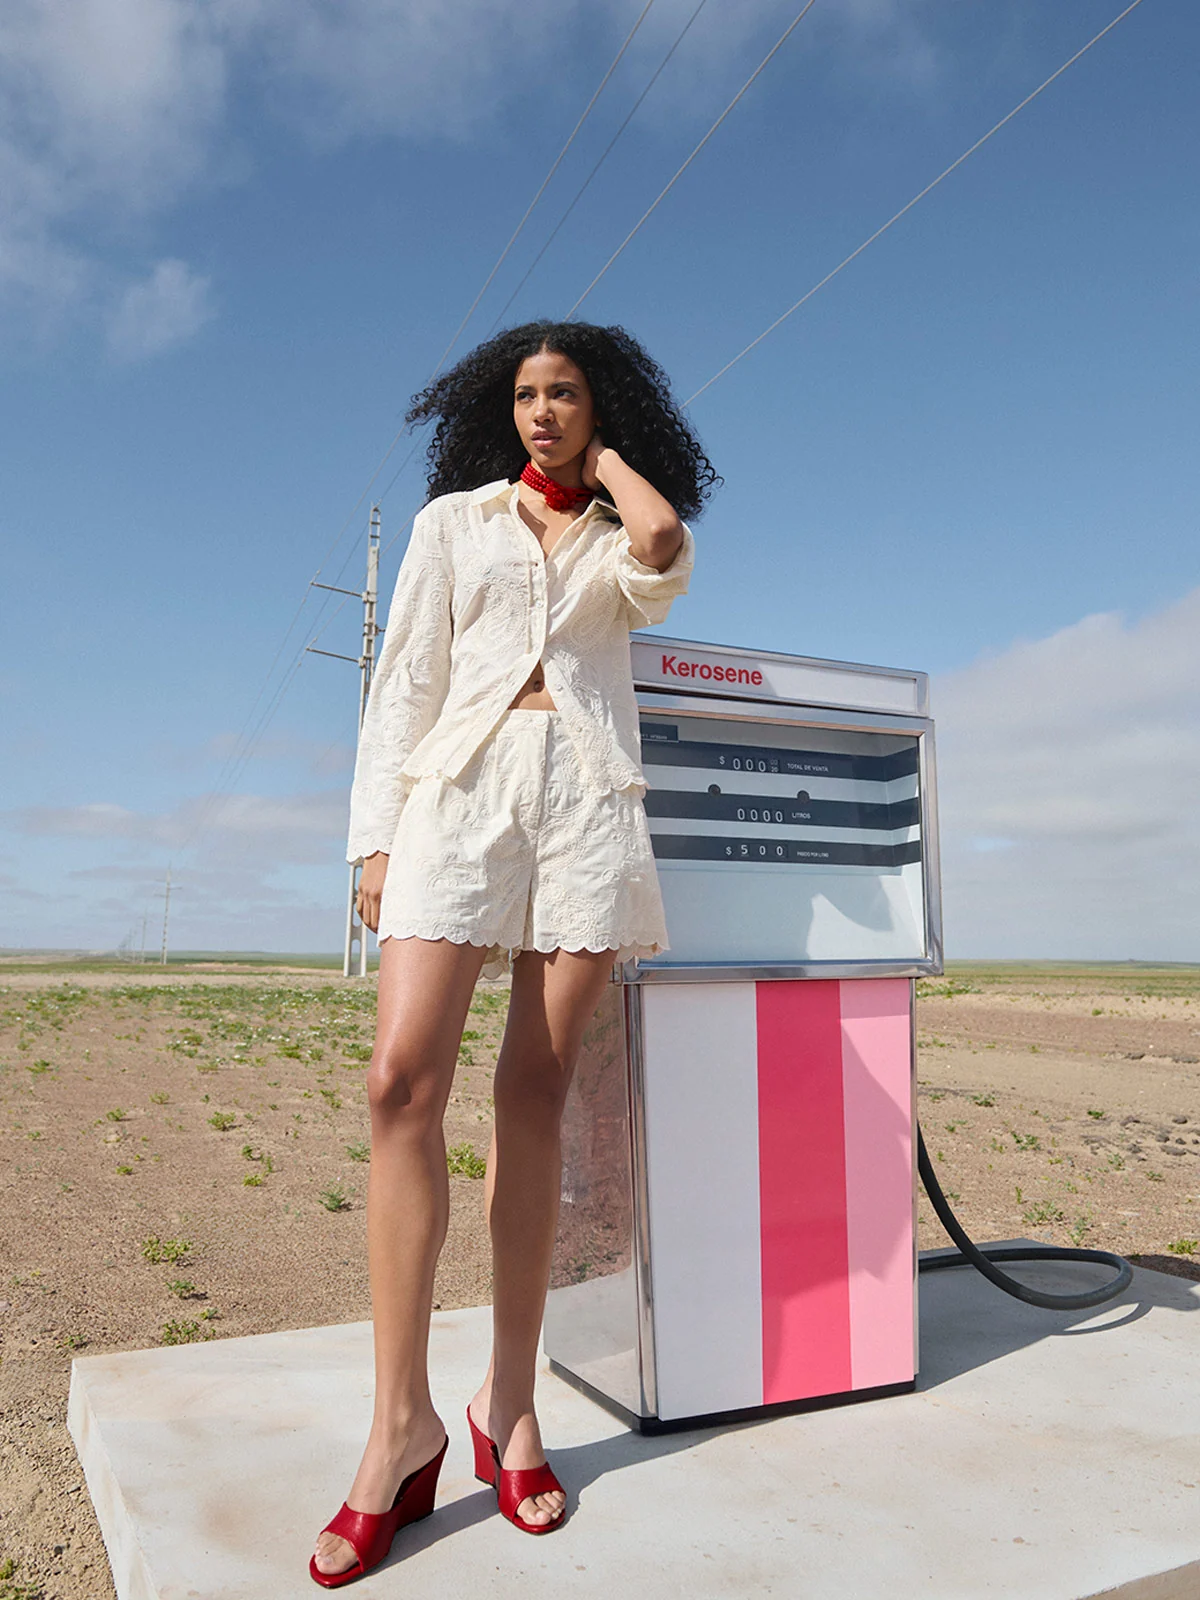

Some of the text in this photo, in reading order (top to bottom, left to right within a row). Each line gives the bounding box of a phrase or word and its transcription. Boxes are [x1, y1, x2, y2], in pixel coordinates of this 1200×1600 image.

[662, 655, 763, 685] Kerosene
[719, 755, 725, 765] $
[725, 846, 732, 855] $
